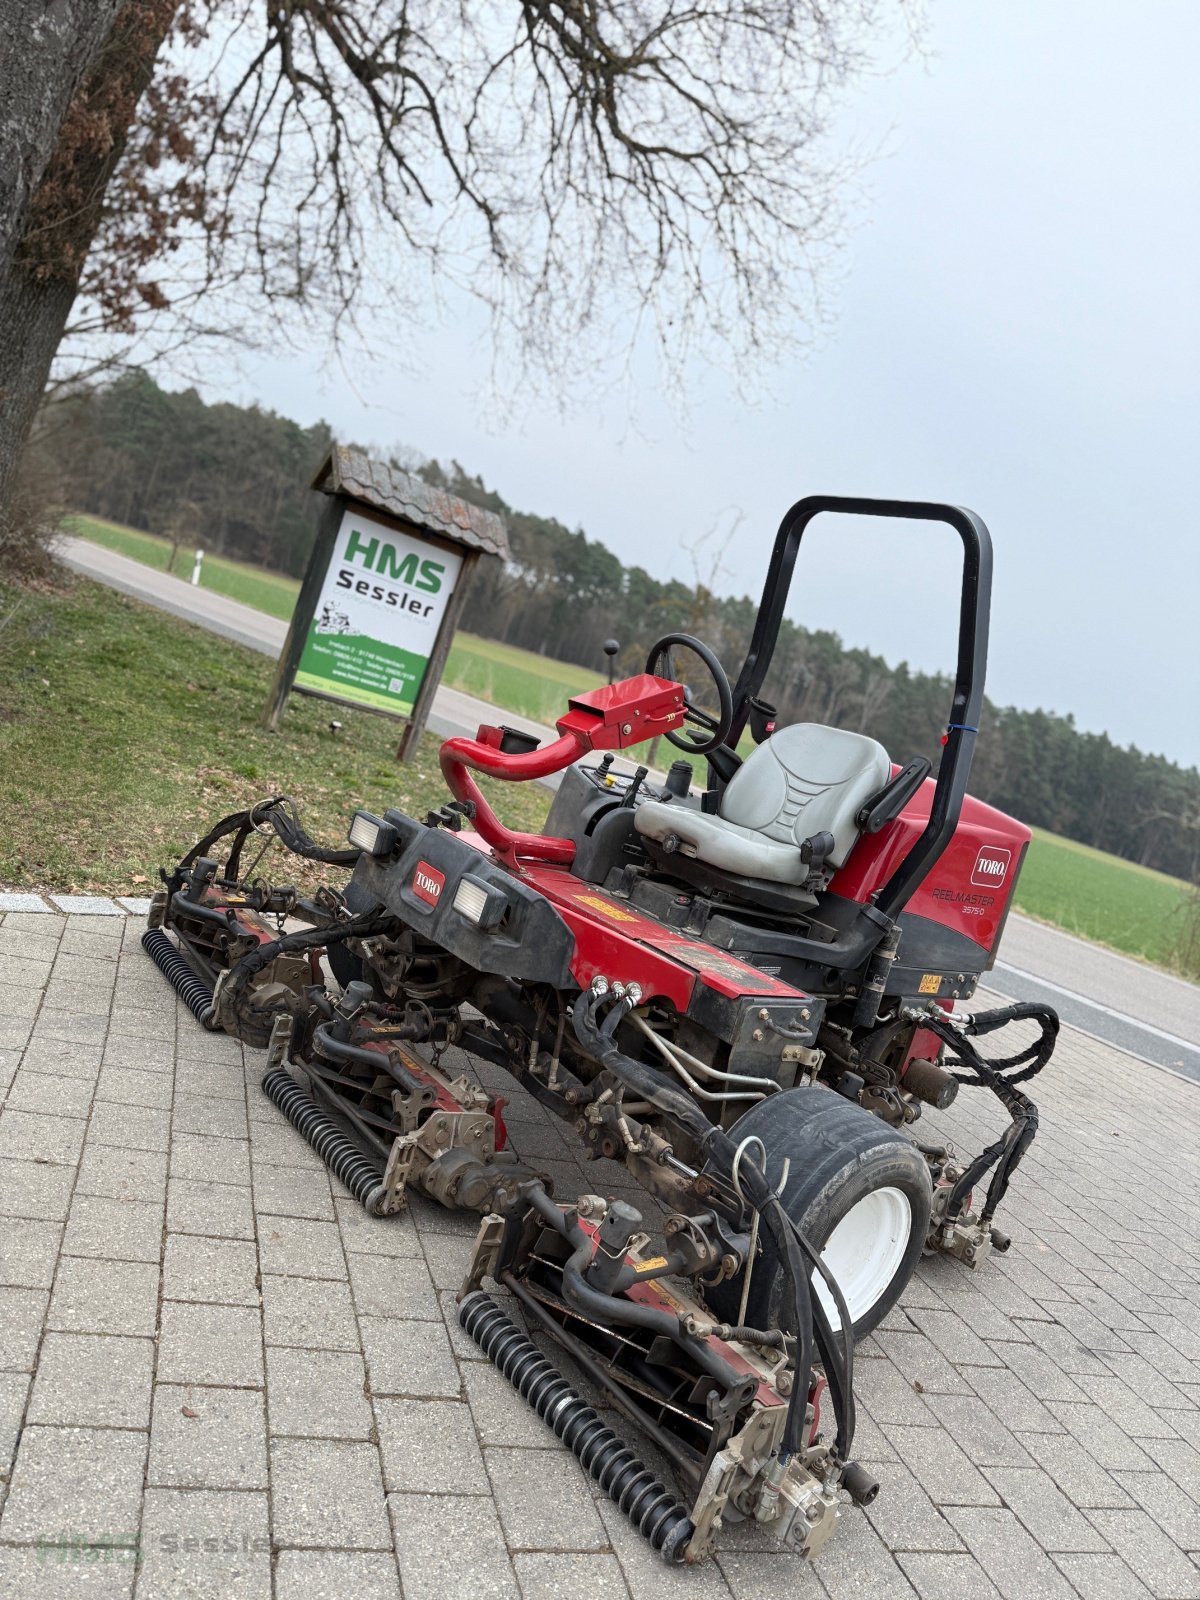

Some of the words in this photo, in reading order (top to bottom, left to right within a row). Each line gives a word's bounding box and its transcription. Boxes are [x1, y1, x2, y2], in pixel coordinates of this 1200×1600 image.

[343, 529, 446, 595] HMS
[336, 569, 434, 618] Sessler
[977, 858, 1004, 876] TORO
[416, 871, 440, 897] TORO
[932, 888, 995, 906] REELMASTER
